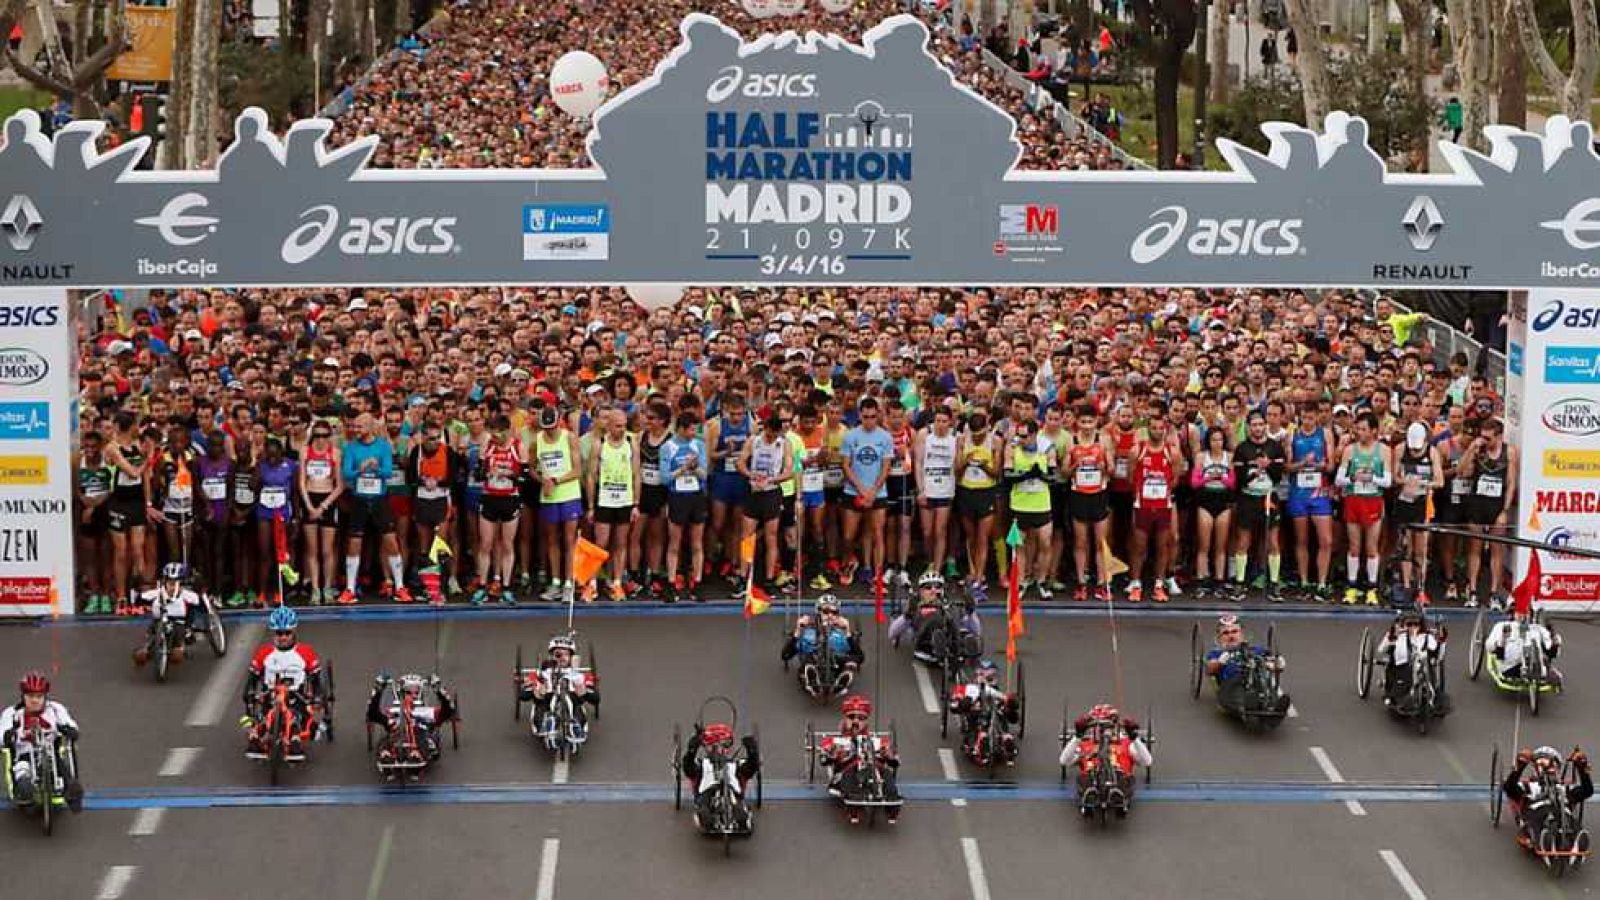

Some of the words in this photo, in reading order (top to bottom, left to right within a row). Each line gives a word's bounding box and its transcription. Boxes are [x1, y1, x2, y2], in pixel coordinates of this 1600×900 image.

[706, 111, 819, 148] HALF
[706, 151, 912, 180] MARATHON
[705, 182, 912, 223] MADRID
[137, 258, 218, 278] iberCaja
[759, 254, 845, 275] 3/4/16
[1372, 264, 1474, 281] RENAULT
[1563, 404, 1591, 414] DON
[4, 499, 66, 514] MUNDO
[2, 529, 39, 562] ZEN
